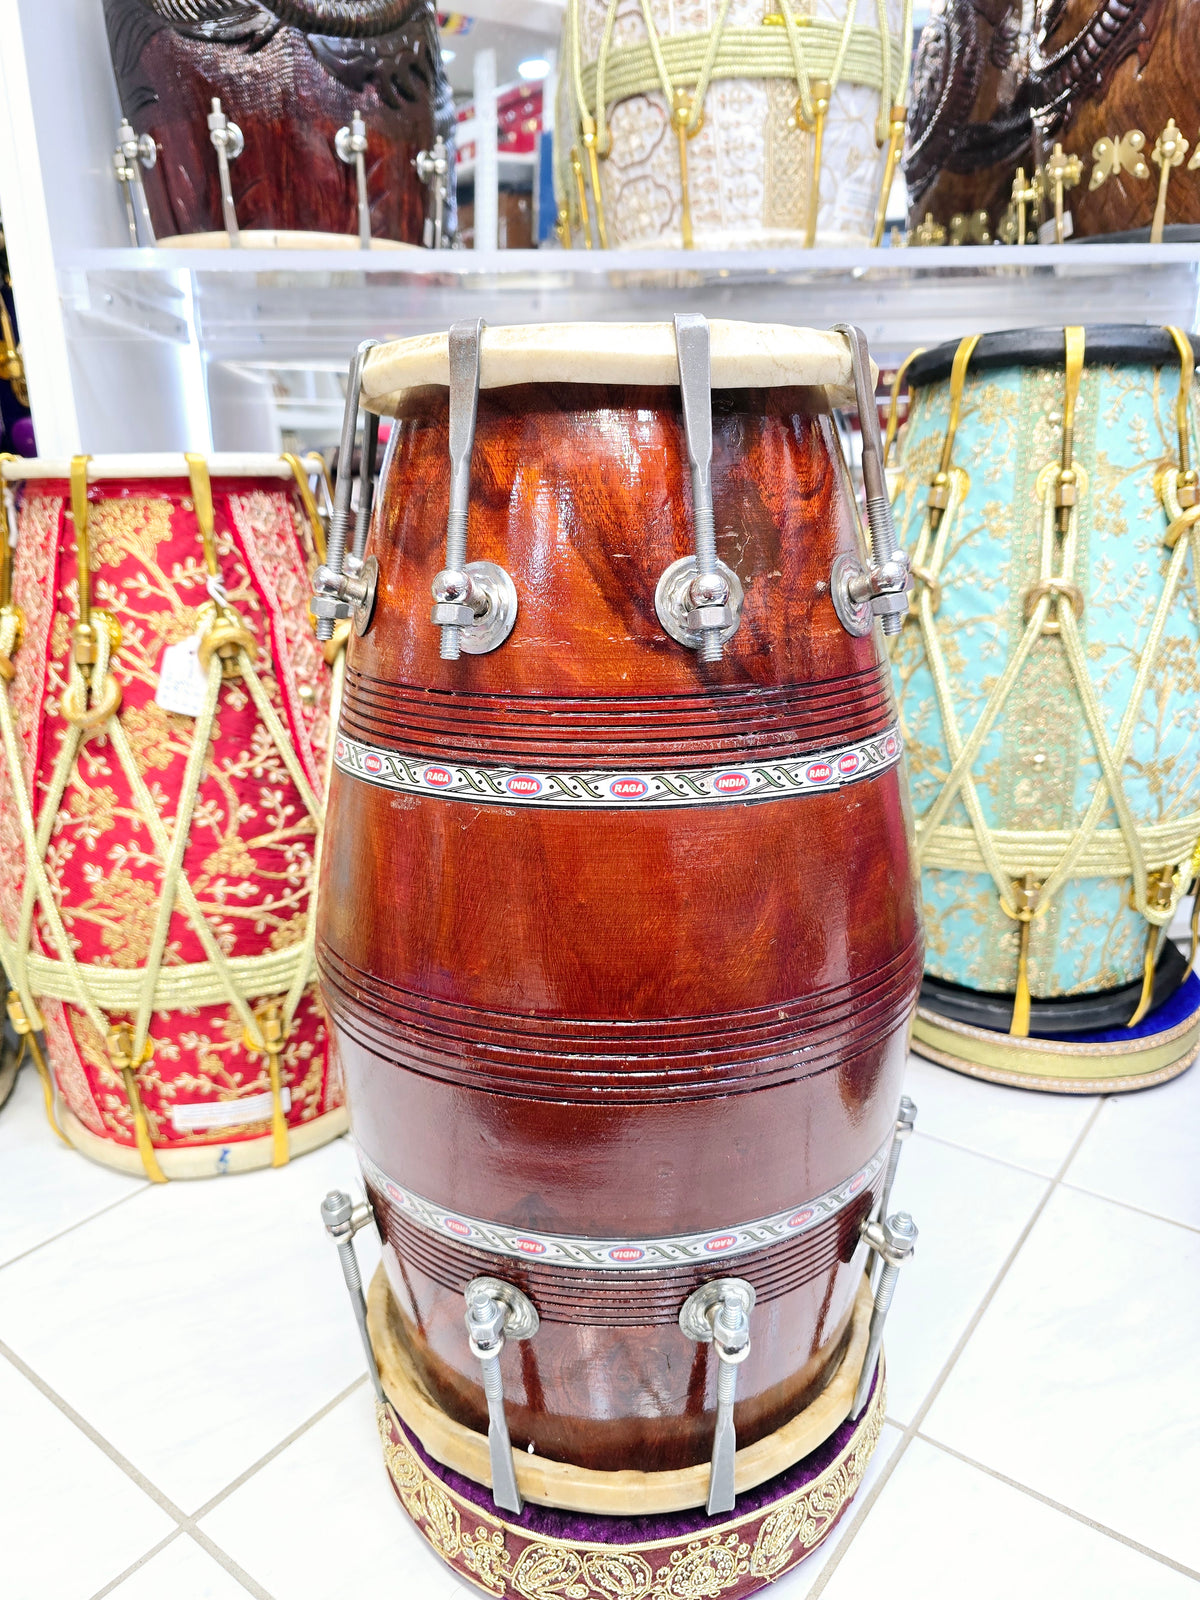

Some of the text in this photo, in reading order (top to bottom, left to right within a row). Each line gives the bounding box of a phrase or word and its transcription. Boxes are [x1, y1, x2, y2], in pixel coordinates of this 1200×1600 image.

[365, 757, 858, 793] INDIA RAGA INDIA RAGA INDIA RAGA INDIA
[446, 1220, 469, 1234] INDIA
[707, 1238, 733, 1249] RAGA
[612, 1249, 640, 1259] INDIA
